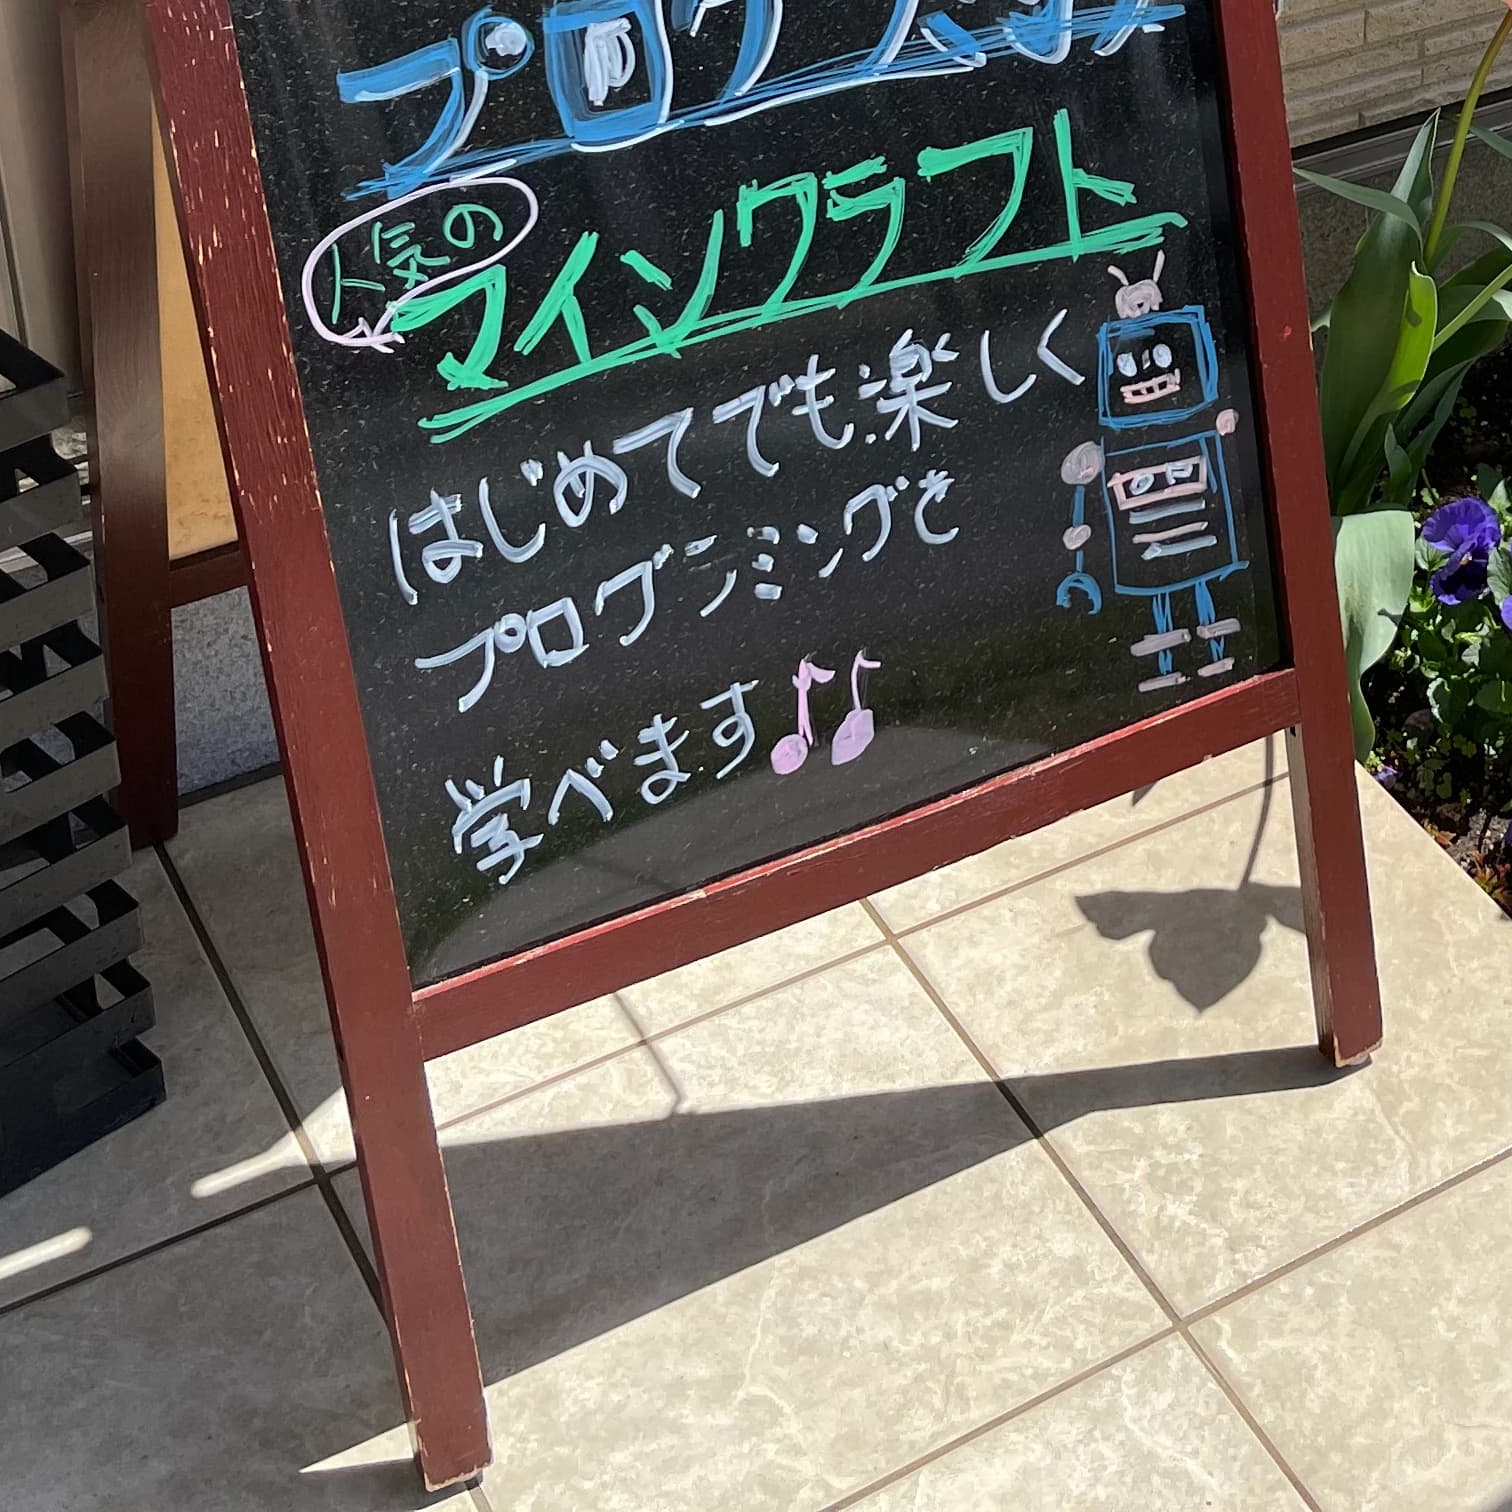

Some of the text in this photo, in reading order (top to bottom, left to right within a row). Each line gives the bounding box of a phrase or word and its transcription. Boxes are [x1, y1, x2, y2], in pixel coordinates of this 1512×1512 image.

[386, 109, 1141, 390] マインクラフト
